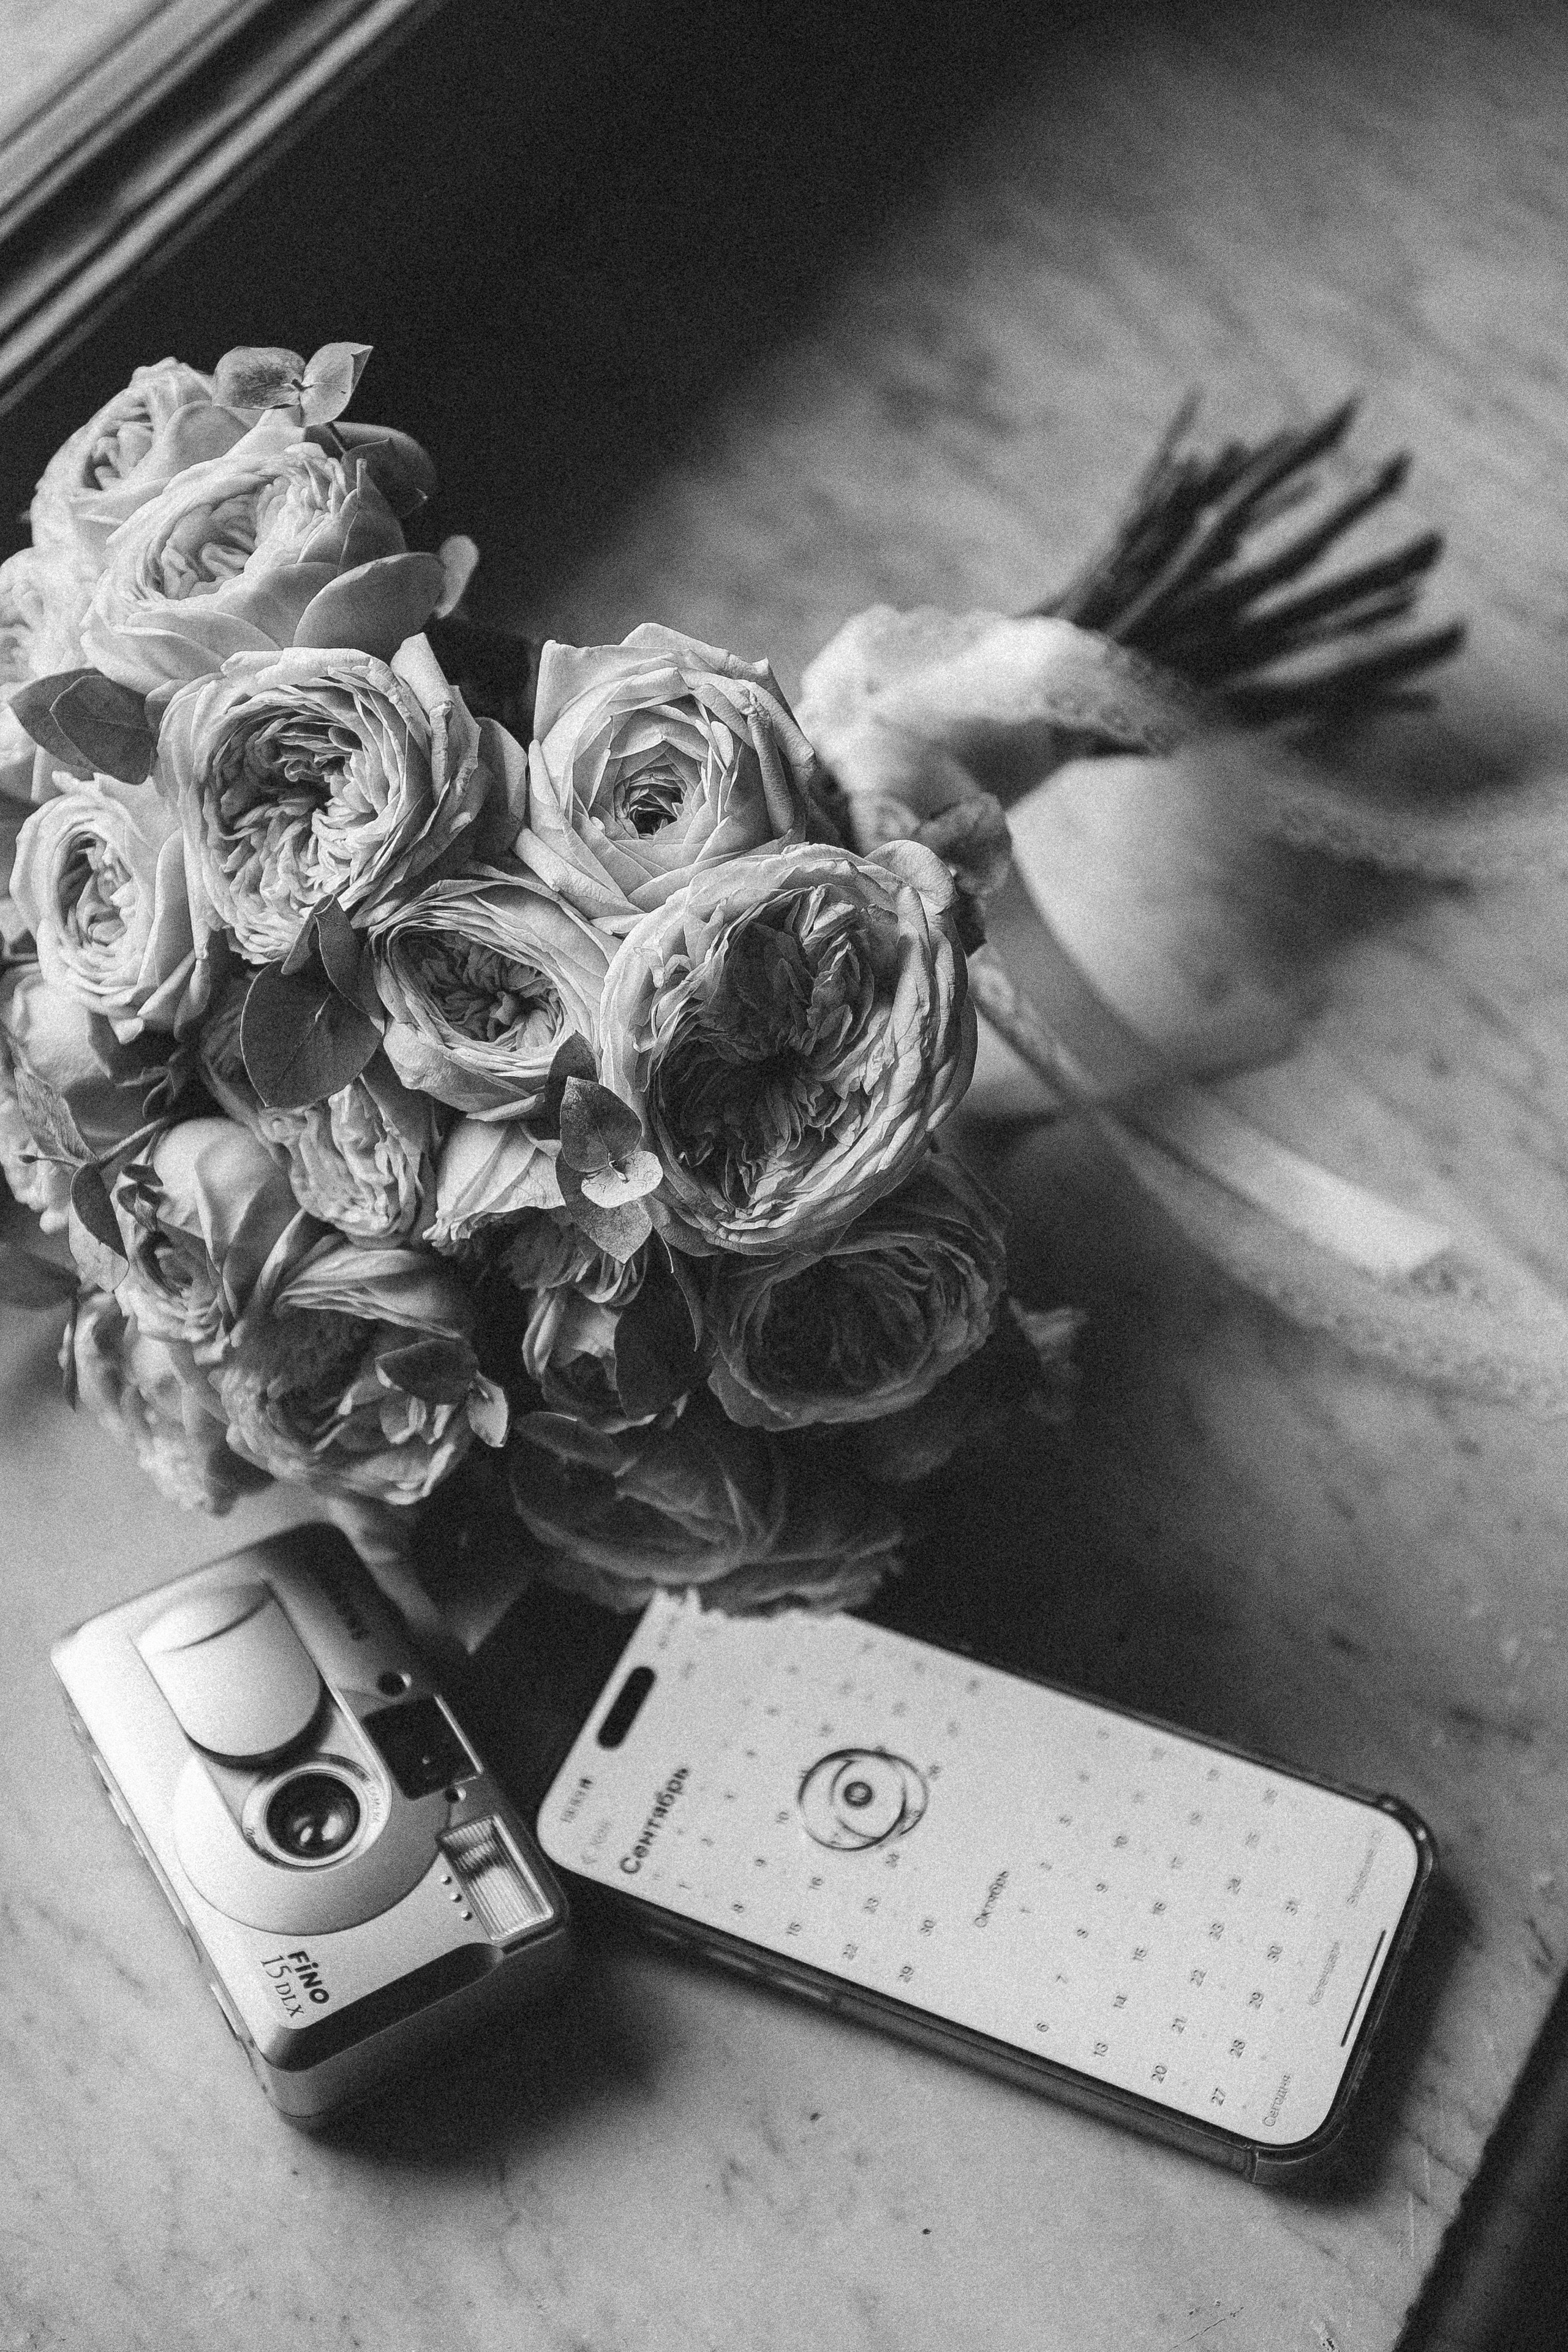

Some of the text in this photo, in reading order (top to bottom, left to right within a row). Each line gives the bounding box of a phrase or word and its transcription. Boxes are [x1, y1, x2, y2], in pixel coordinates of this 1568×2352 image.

[619, 1767, 690, 1875] Сентябрь
[731, 1810, 790, 1913] 8 9 10
[786, 1921, 802, 1937] 15
[808, 1875, 824, 1891] 16
[842, 1942, 859, 1960] 22
[862, 1896, 880, 1915] 23
[974, 1870, 1009, 1928] Октябрь
[260, 1955, 305, 2018] 15 DLX
[898, 1918, 936, 1983] 29 30
[1035, 2021, 1050, 2034] 6
[1055, 1973, 1068, 1984] 7
[1076, 1927, 1090, 1939] 8
[1095, 1882, 1109, 1893] 9
[1092, 2041, 1109, 2057] 13
[1112, 1994, 1128, 2010] 14
[1132, 1947, 1148, 1962] 15
[1152, 1901, 1167, 1916] 16
[1150, 2064, 1167, 2084] 20
[1170, 2016, 1186, 2034] 21
[1189, 1969, 1207, 1987] 22
[1208, 1922, 1225, 1940] 23
[1210, 1899, 1299, 2107] 27 28 29 30 31
[1262, 2074, 1291, 2127] Сегодня
